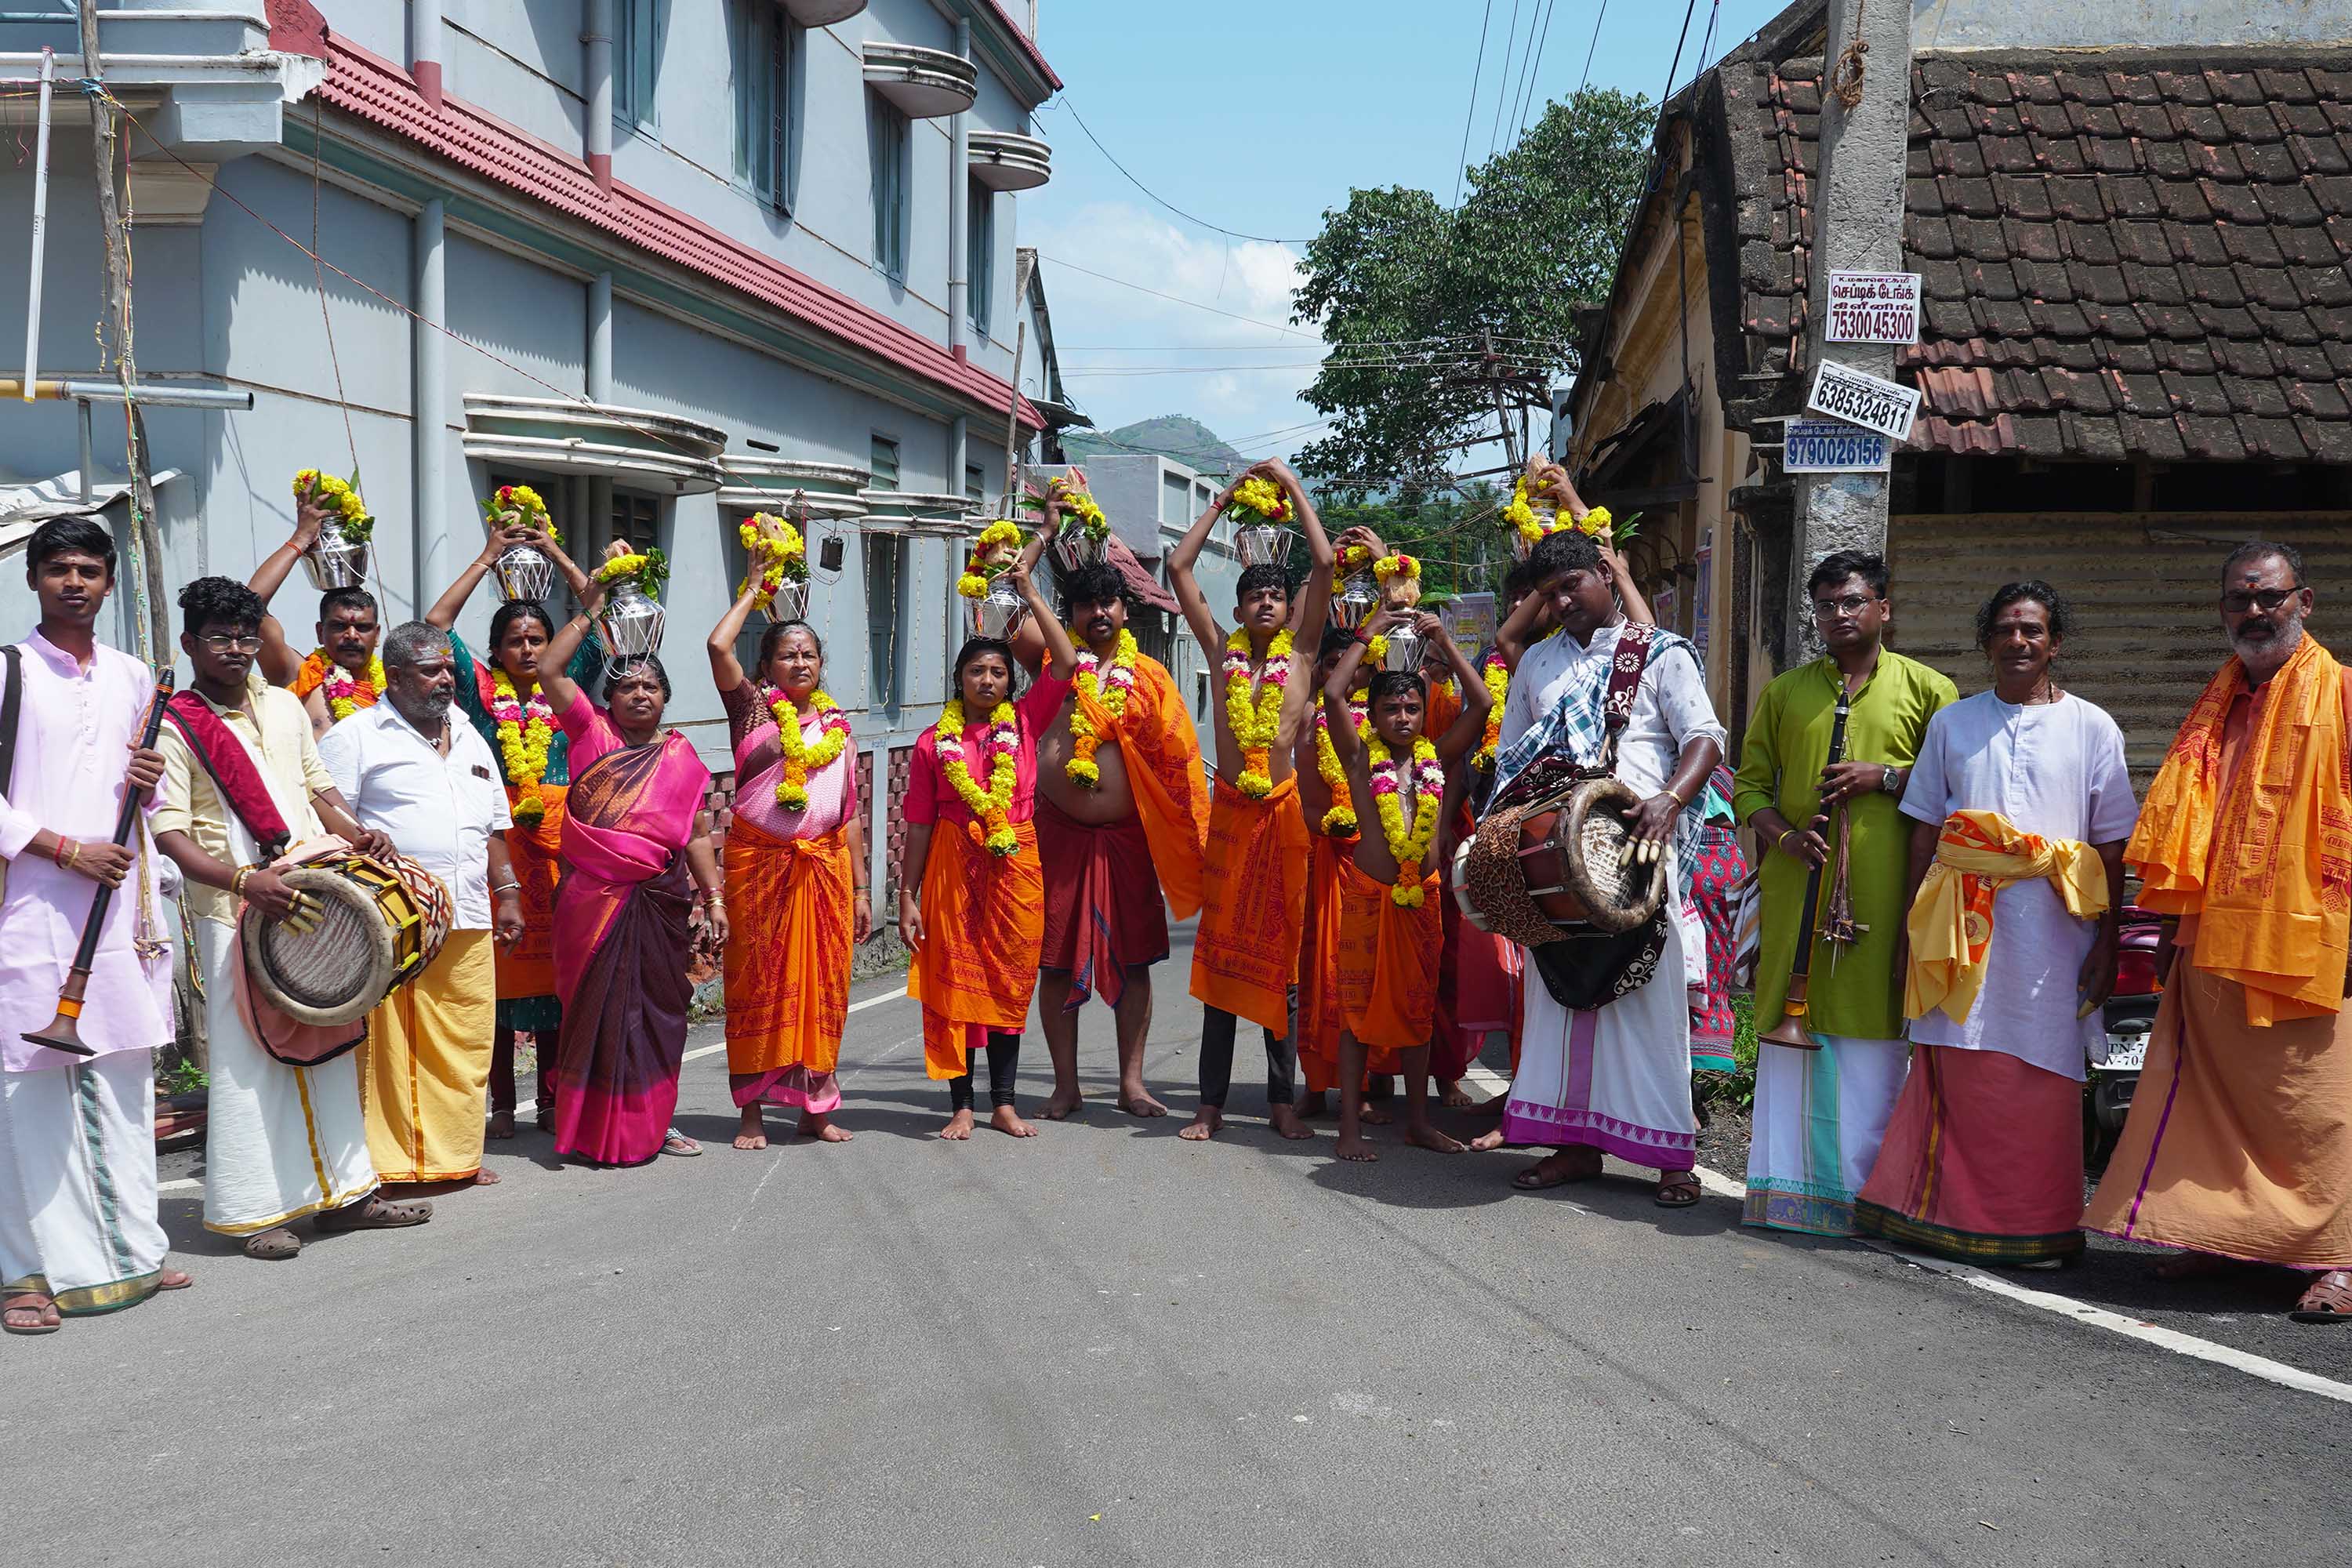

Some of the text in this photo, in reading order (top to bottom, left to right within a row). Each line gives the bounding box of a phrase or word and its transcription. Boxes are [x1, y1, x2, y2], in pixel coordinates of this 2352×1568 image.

[1833, 283, 1914, 301] செப்டிக் டேங்க்
[1817, 382, 1907, 433] 6385324811
[1788, 438, 1882, 464] 9790026156
